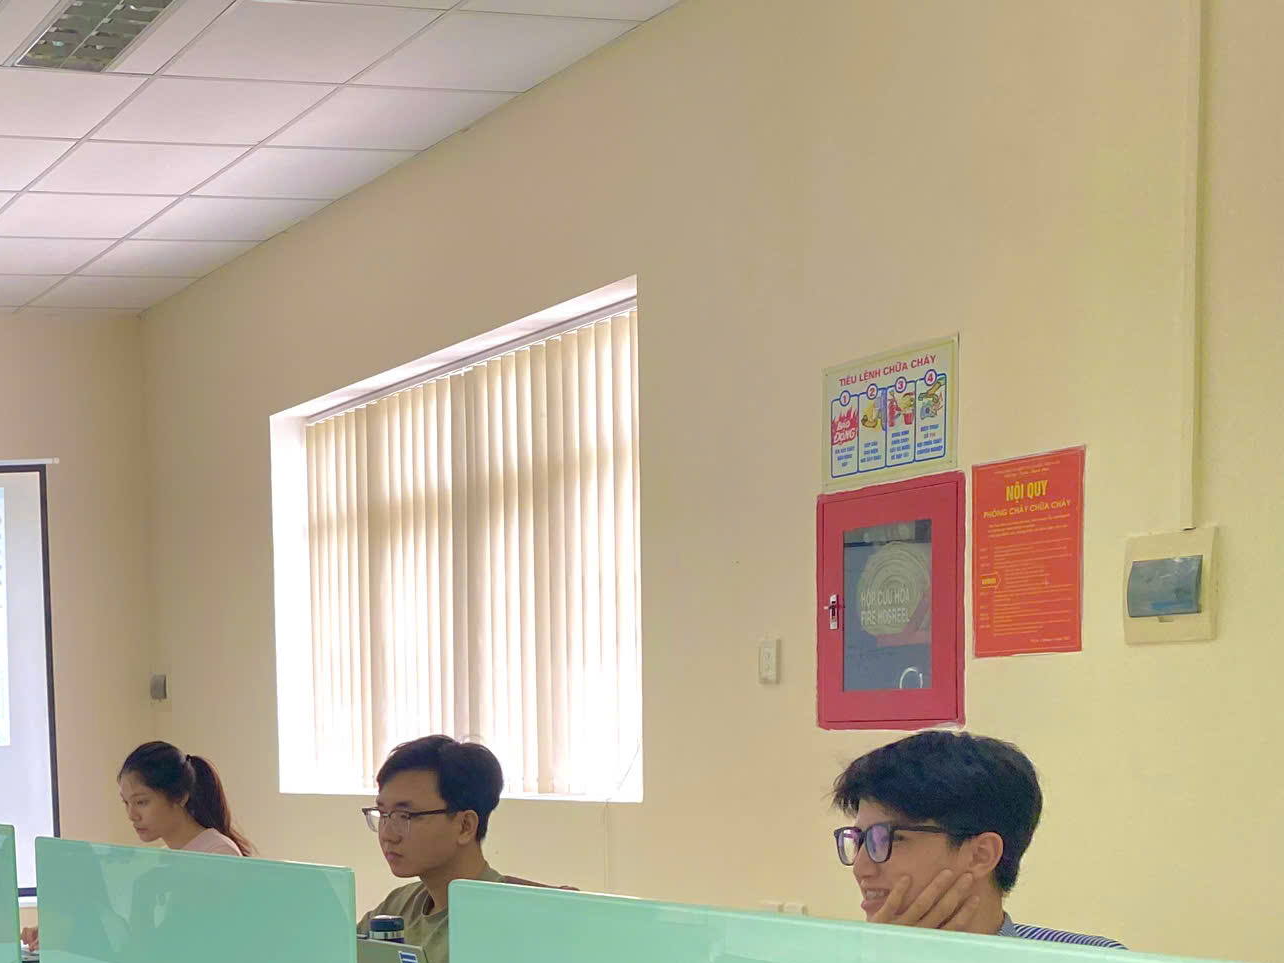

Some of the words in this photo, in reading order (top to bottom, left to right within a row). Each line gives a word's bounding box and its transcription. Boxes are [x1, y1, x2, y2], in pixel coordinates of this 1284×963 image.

[883, 361, 908, 376] CHỮA
[911, 354, 937, 369] CHÁY
[1006, 481, 1024, 503] NỘI
[1027, 479, 1048, 499] QUY
